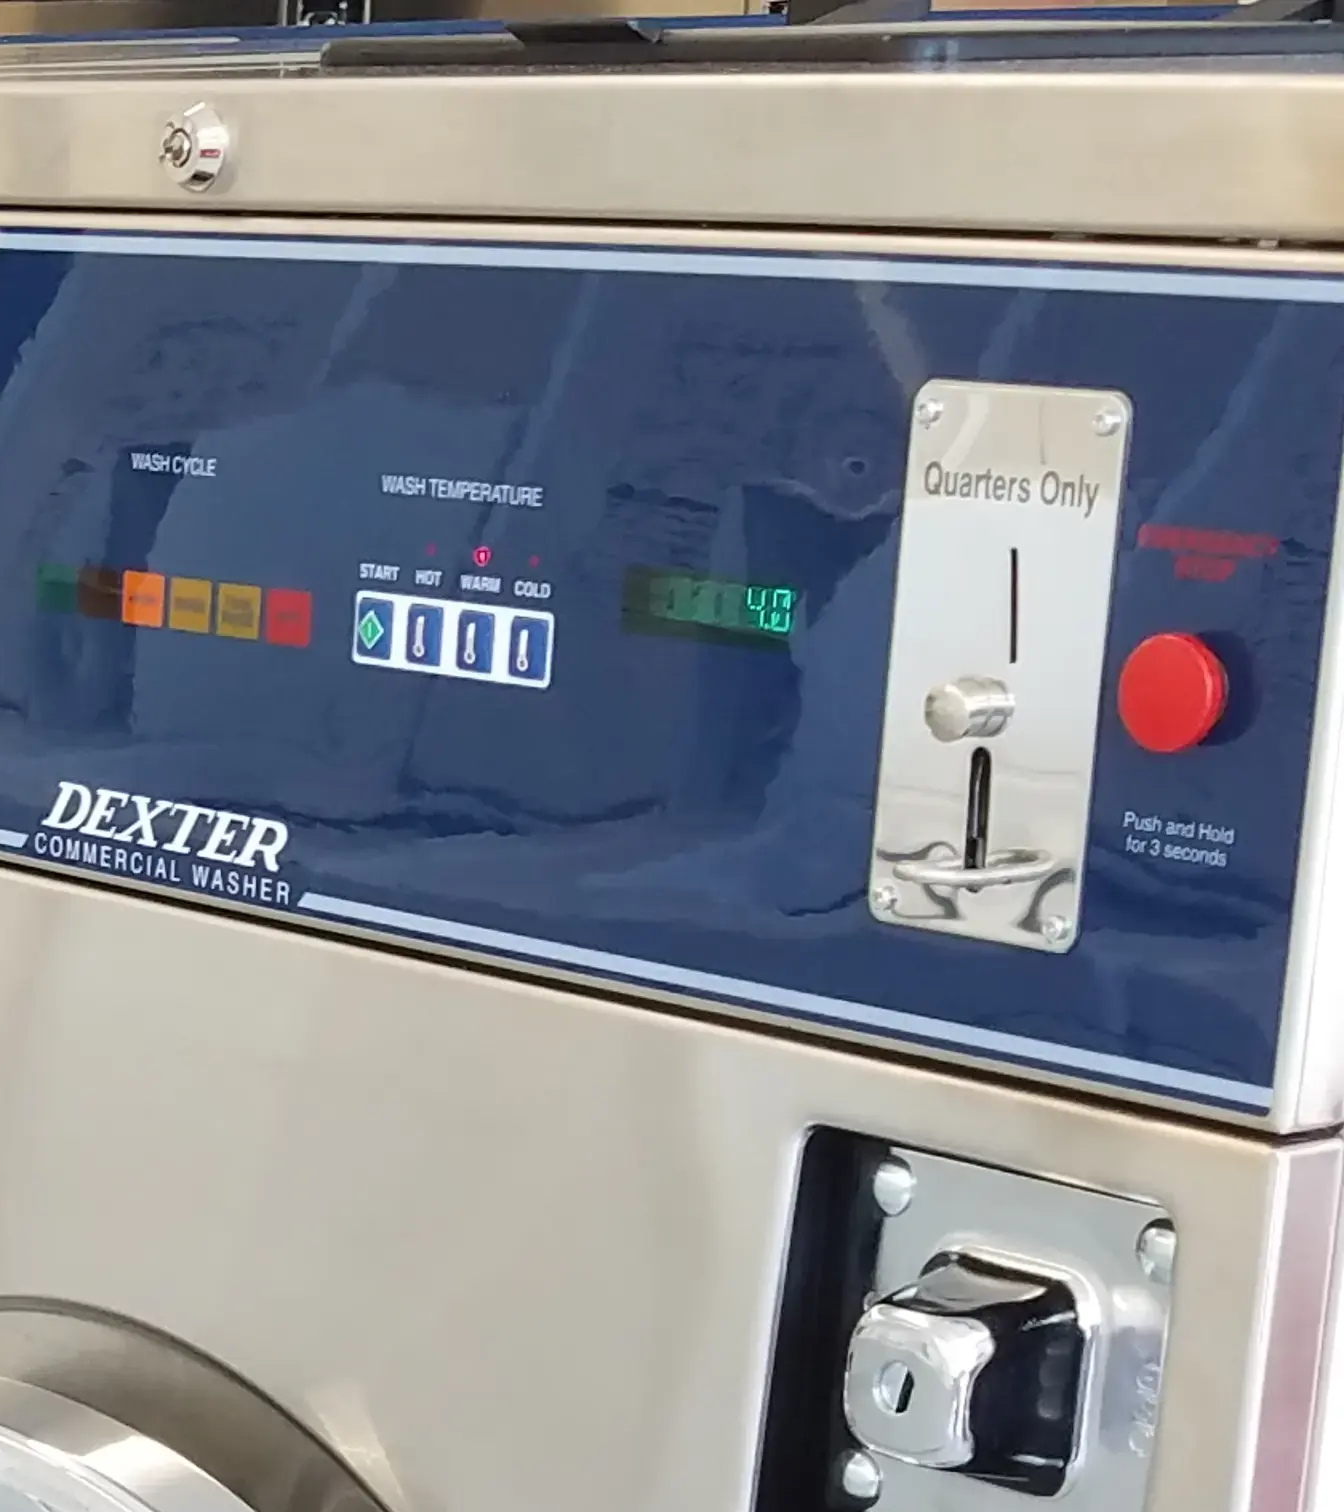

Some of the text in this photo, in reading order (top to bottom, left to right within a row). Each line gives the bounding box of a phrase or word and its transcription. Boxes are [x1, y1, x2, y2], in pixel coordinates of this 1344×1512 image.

[130, 451, 218, 477] WASH CYCLE
[381, 474, 544, 507] WASH TEMPERATURE
[923, 460, 1101, 519] Quarters Only
[359, 563, 552, 599] START HOT WARM COLD
[40, 780, 290, 873] DEXTER
[1122, 811, 1235, 845] Push and Hold
[33, 831, 291, 906] COMMERCIAL WASHER
[1125, 834, 1228, 868] for 3 seconds
